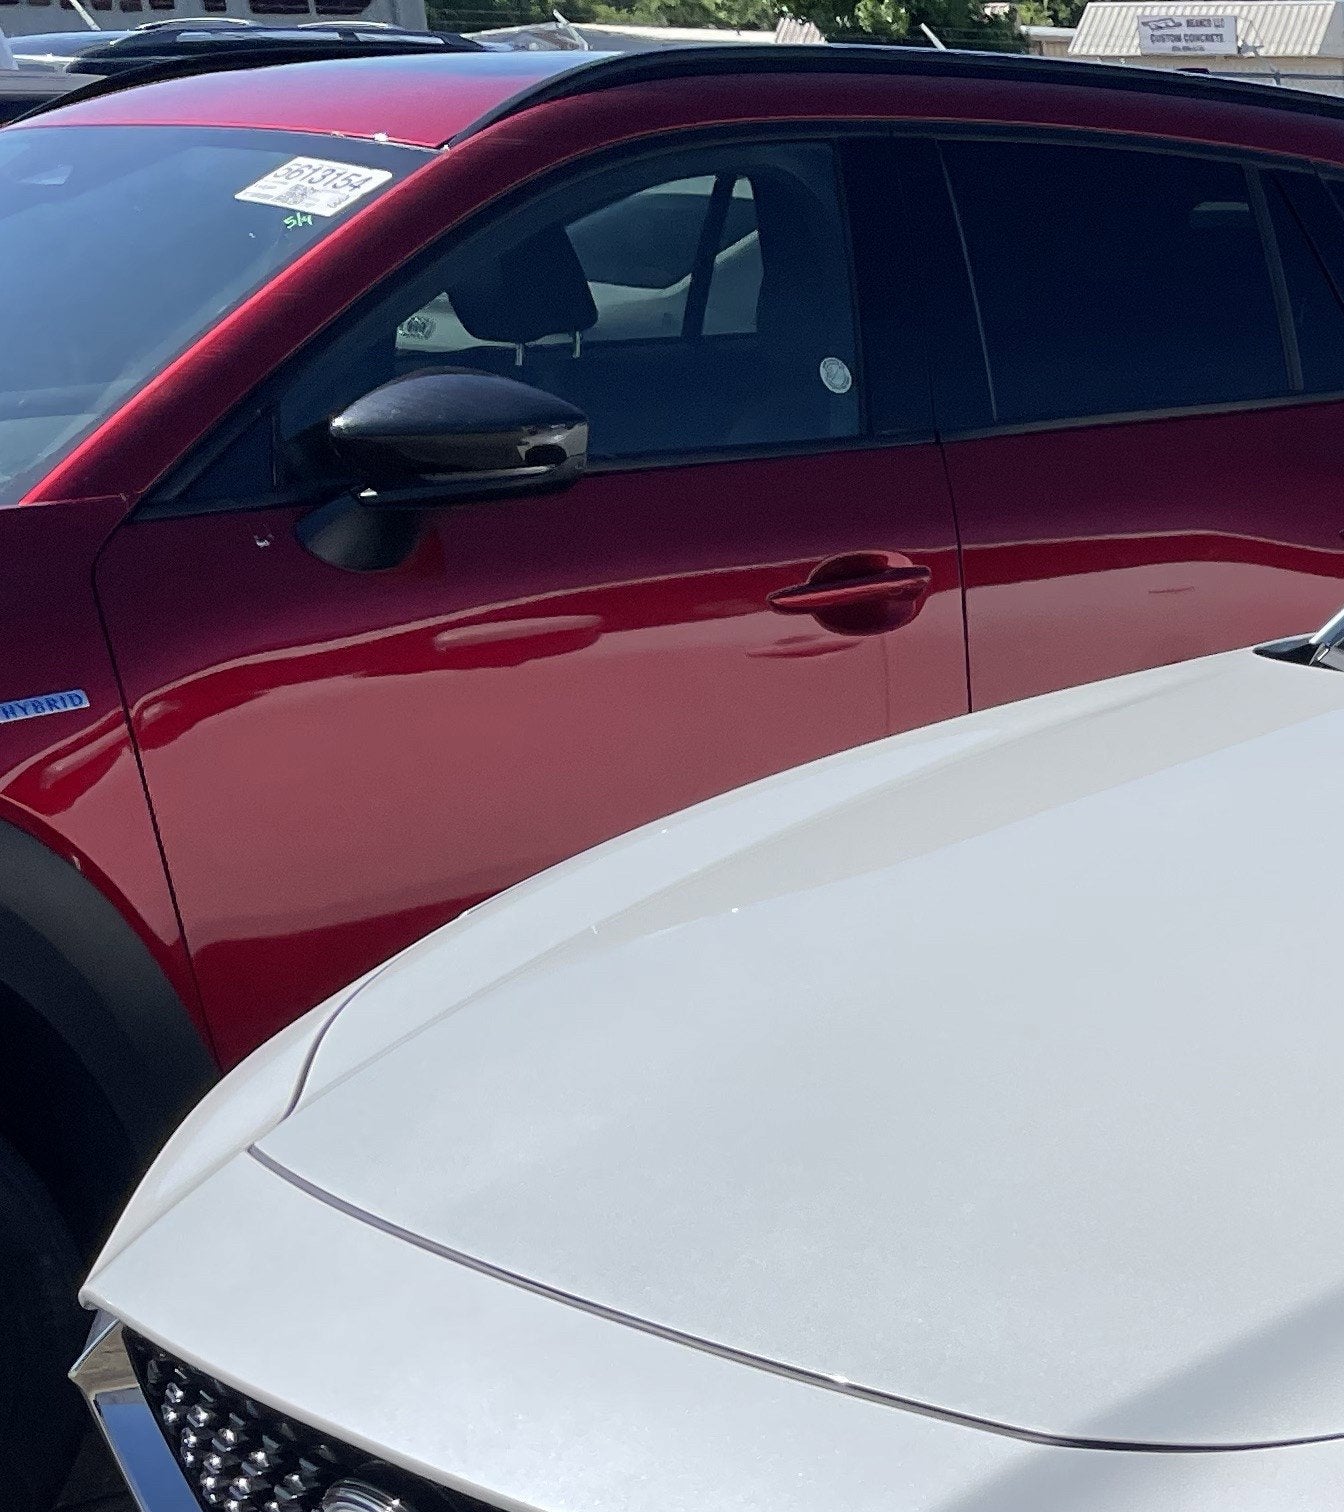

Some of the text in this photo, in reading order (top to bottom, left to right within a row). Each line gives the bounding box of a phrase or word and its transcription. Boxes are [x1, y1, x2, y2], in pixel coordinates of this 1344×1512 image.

[1150, 33, 1224, 43] CUSTOM CONCRETE
[273, 163, 373, 191] 5613154
[1, 692, 84, 720] HYBRID
